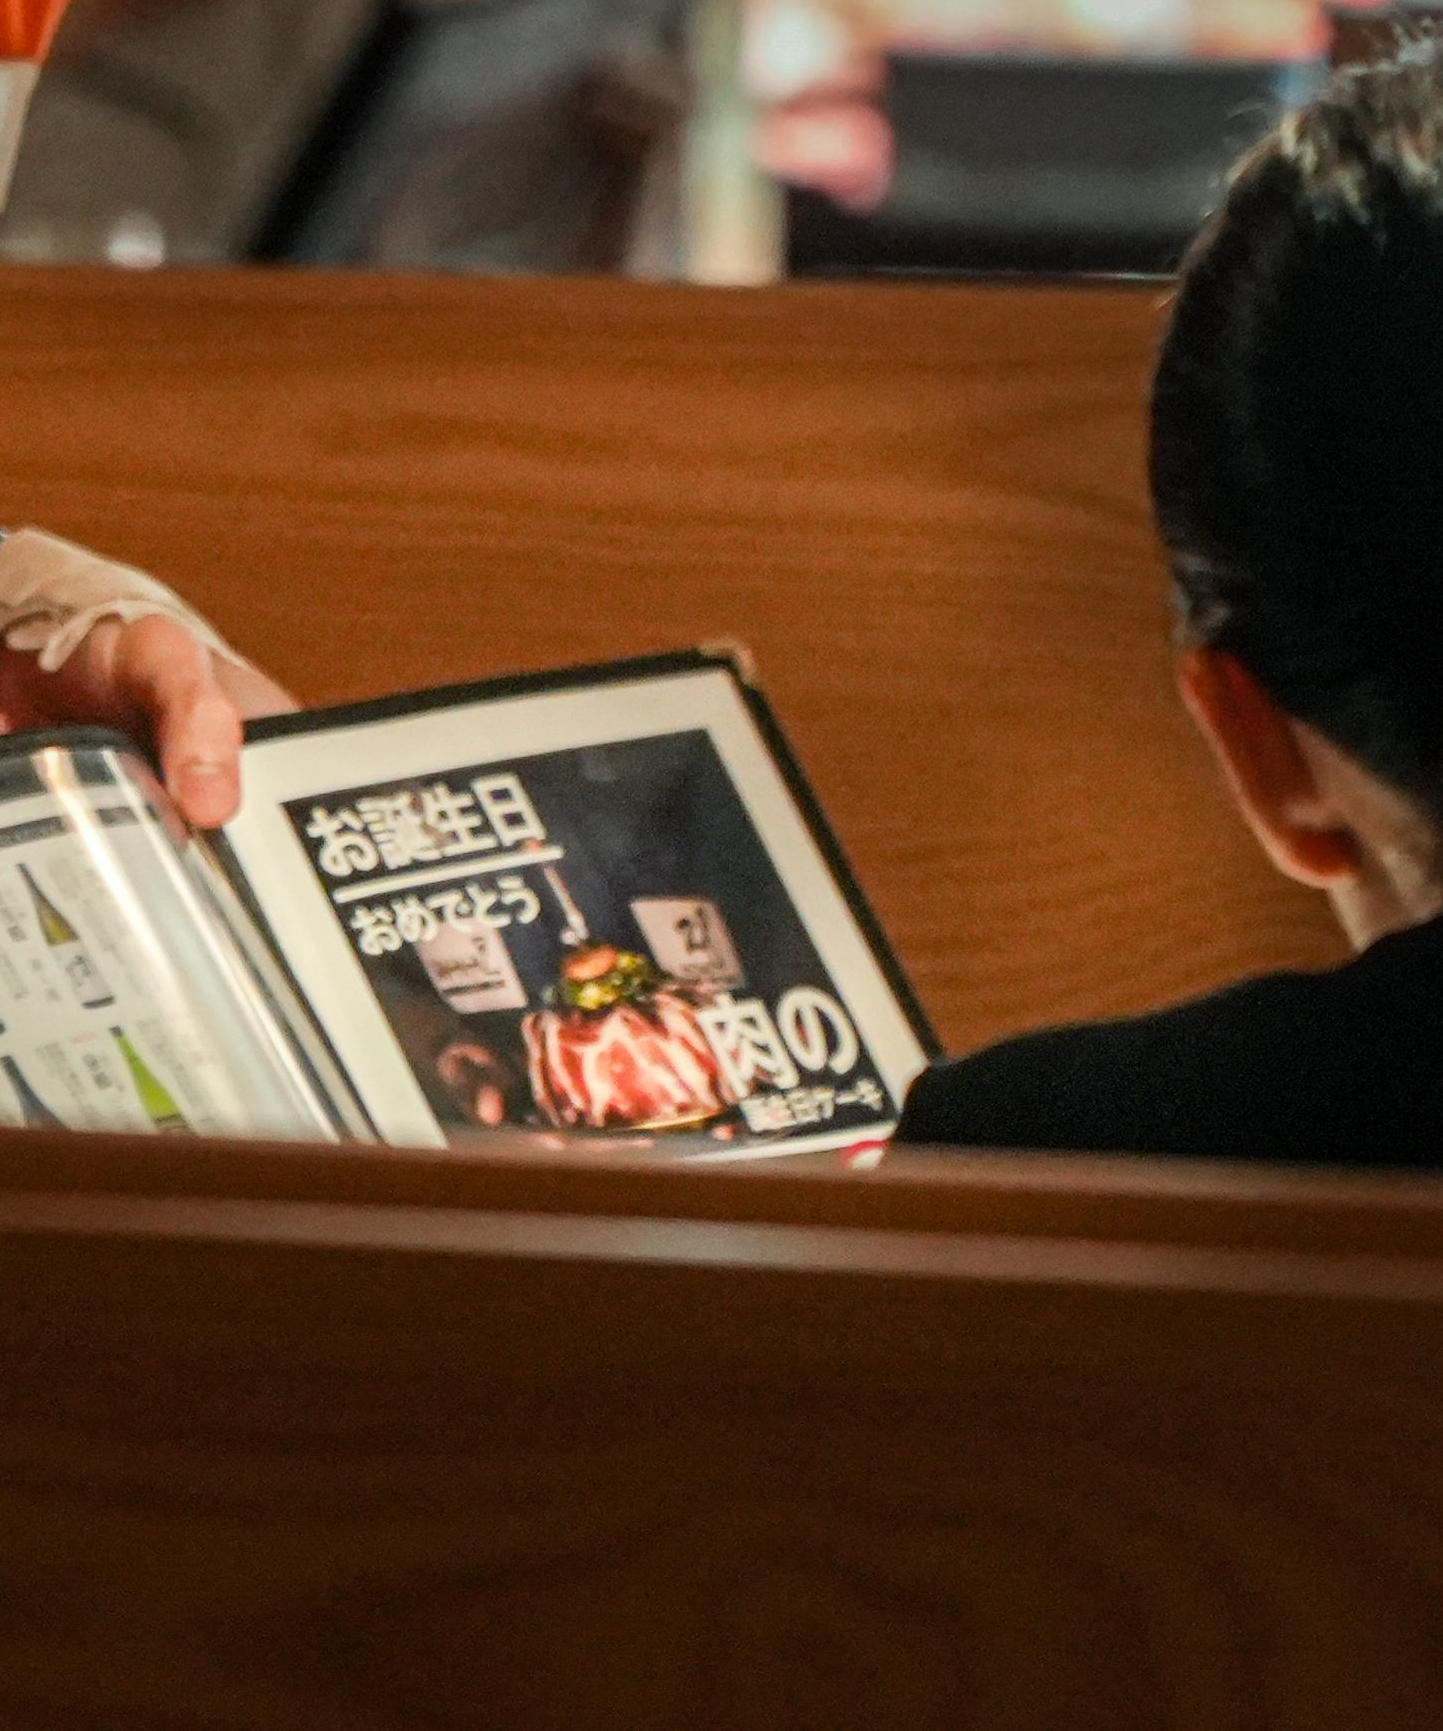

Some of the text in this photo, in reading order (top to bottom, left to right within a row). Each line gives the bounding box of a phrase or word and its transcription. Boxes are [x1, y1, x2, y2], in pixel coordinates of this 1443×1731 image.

[306, 771, 548, 877] お誕生日
[350, 874, 542, 956] おめでとう
[697, 984, 859, 1105] 肉の
